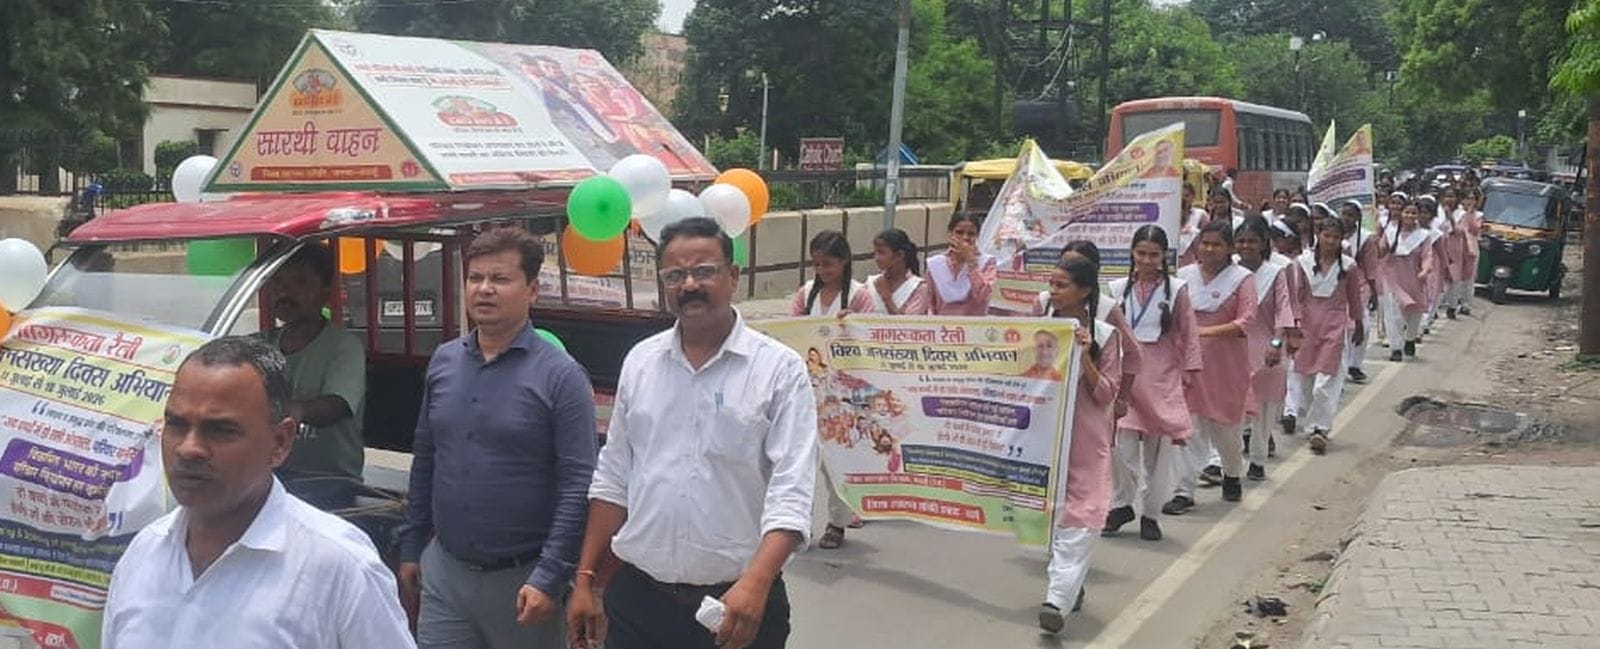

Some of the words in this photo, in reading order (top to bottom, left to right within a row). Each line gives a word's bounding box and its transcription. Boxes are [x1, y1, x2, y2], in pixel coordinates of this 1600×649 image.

[257, 121, 318, 156] सारथी
[326, 127, 383, 157] वाहन
[107, 331, 143, 361] रैली
[869, 328, 935, 342] जागरूकता
[940, 325, 966, 342] रैली
[864, 347, 919, 361] जनसंख्या
[922, 346, 957, 361] दिवस
[964, 348, 1017, 362] अभियान
[62, 356, 111, 388] दिवस
